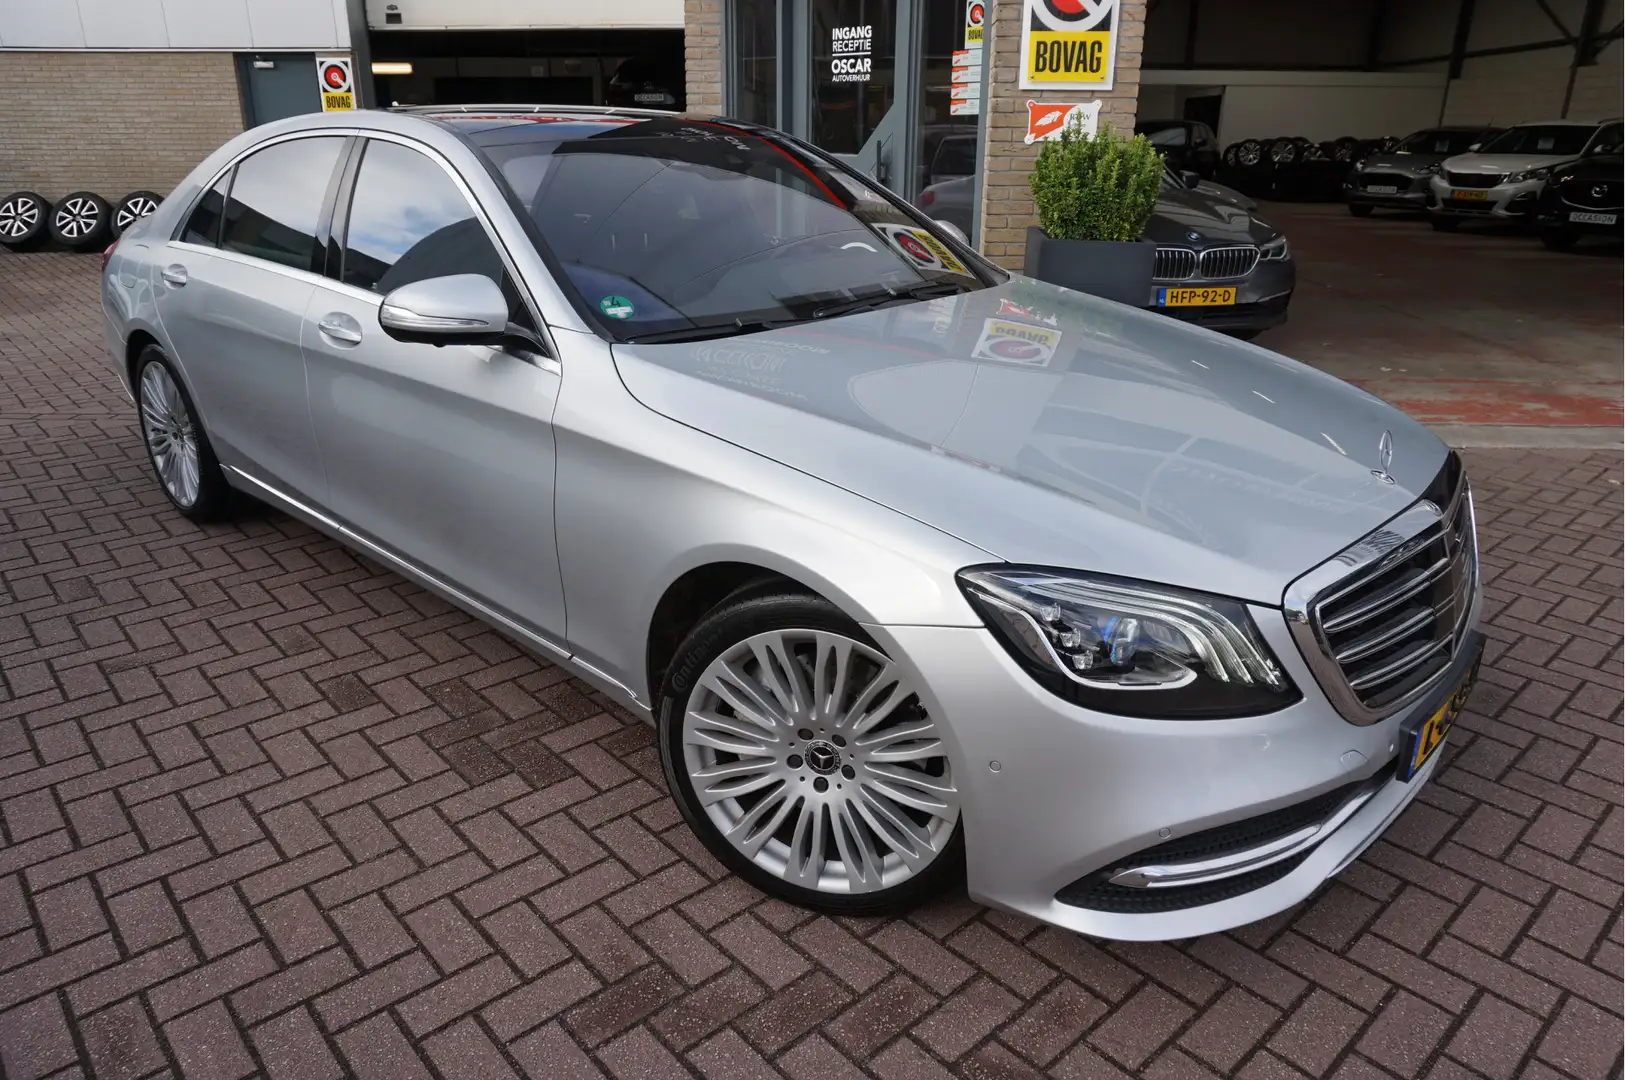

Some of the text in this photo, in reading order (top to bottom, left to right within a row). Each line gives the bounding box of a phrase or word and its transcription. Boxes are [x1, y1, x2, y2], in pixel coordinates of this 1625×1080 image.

[832, 25, 872, 40] INGANG
[832, 39, 872, 52] RECEPTIE
[1034, 40, 1103, 74] BOVAG
[831, 58, 872, 74] OSCAR
[832, 74, 871, 82] AUTOVERHUUR
[325, 95, 351, 109] BOVAG
[1070, 113, 1091, 121] RW
[611, 296, 621, 307] 4
[1170, 290, 1231, 304] HFP-92-D
